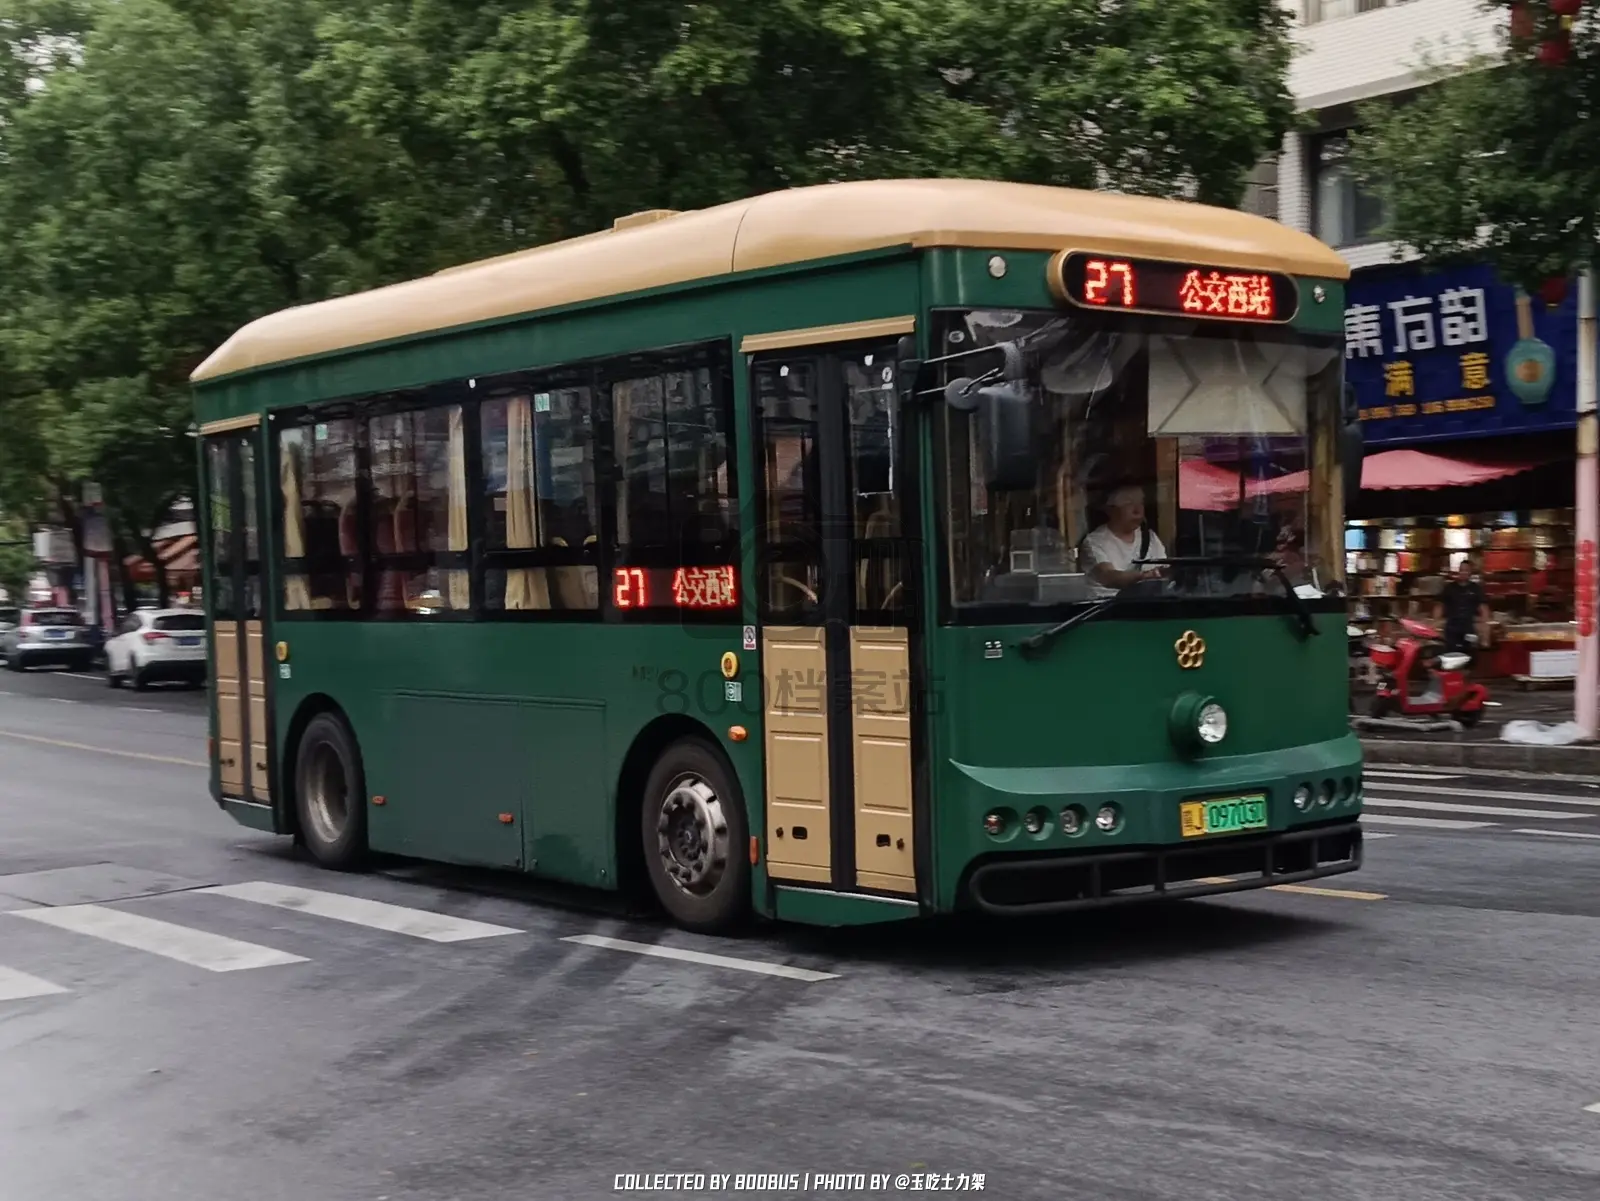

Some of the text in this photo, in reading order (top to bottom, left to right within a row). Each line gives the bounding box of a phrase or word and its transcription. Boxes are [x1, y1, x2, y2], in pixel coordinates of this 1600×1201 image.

[1085, 261, 1272, 316] 27 公交西站
[616, 565, 735, 606] 27 公交西站
